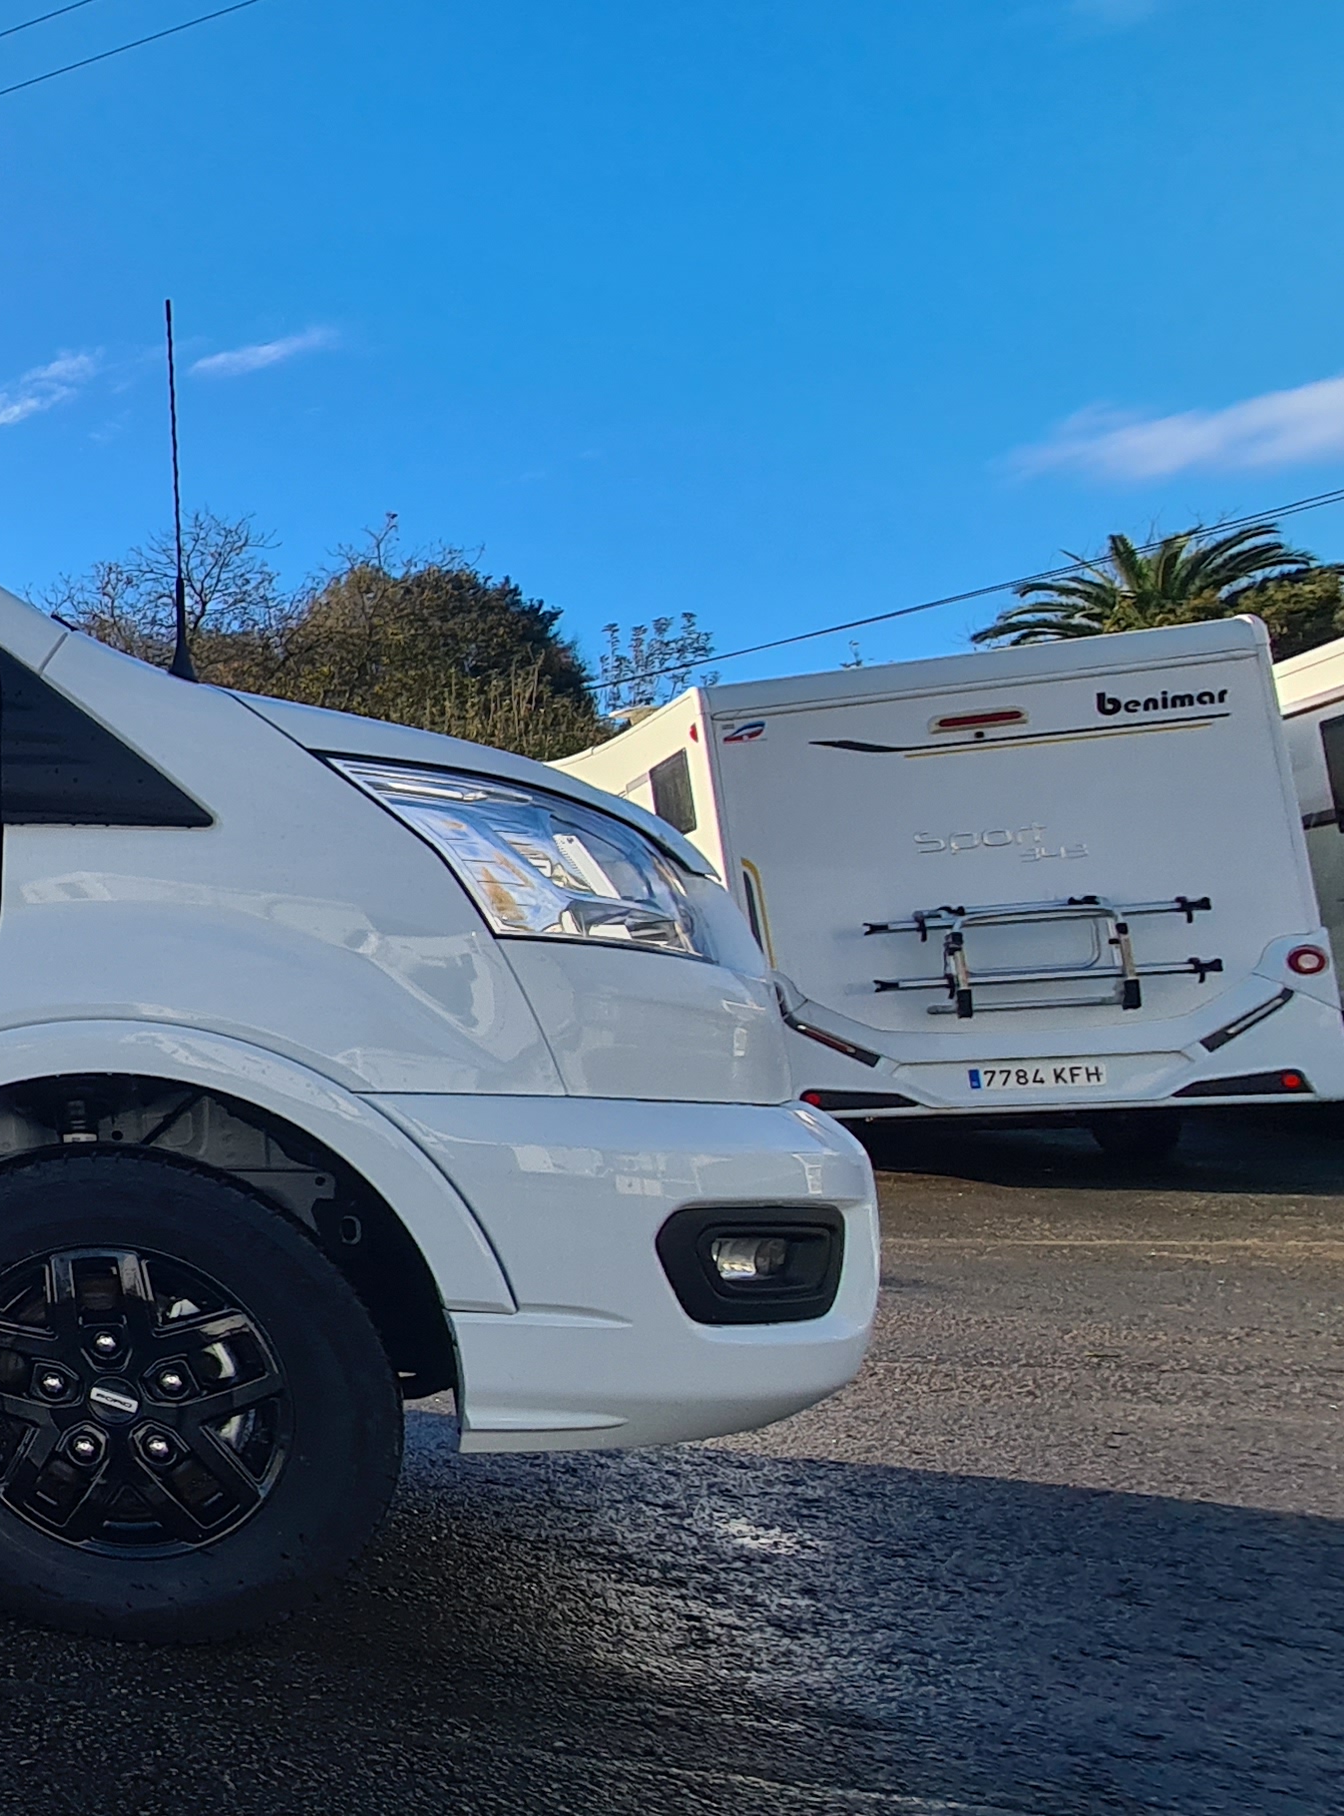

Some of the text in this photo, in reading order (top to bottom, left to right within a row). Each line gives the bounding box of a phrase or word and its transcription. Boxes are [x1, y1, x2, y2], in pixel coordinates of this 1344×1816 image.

[1096, 689, 1228, 716] benimar
[983, 1066, 1101, 1088] 7784 KFH
